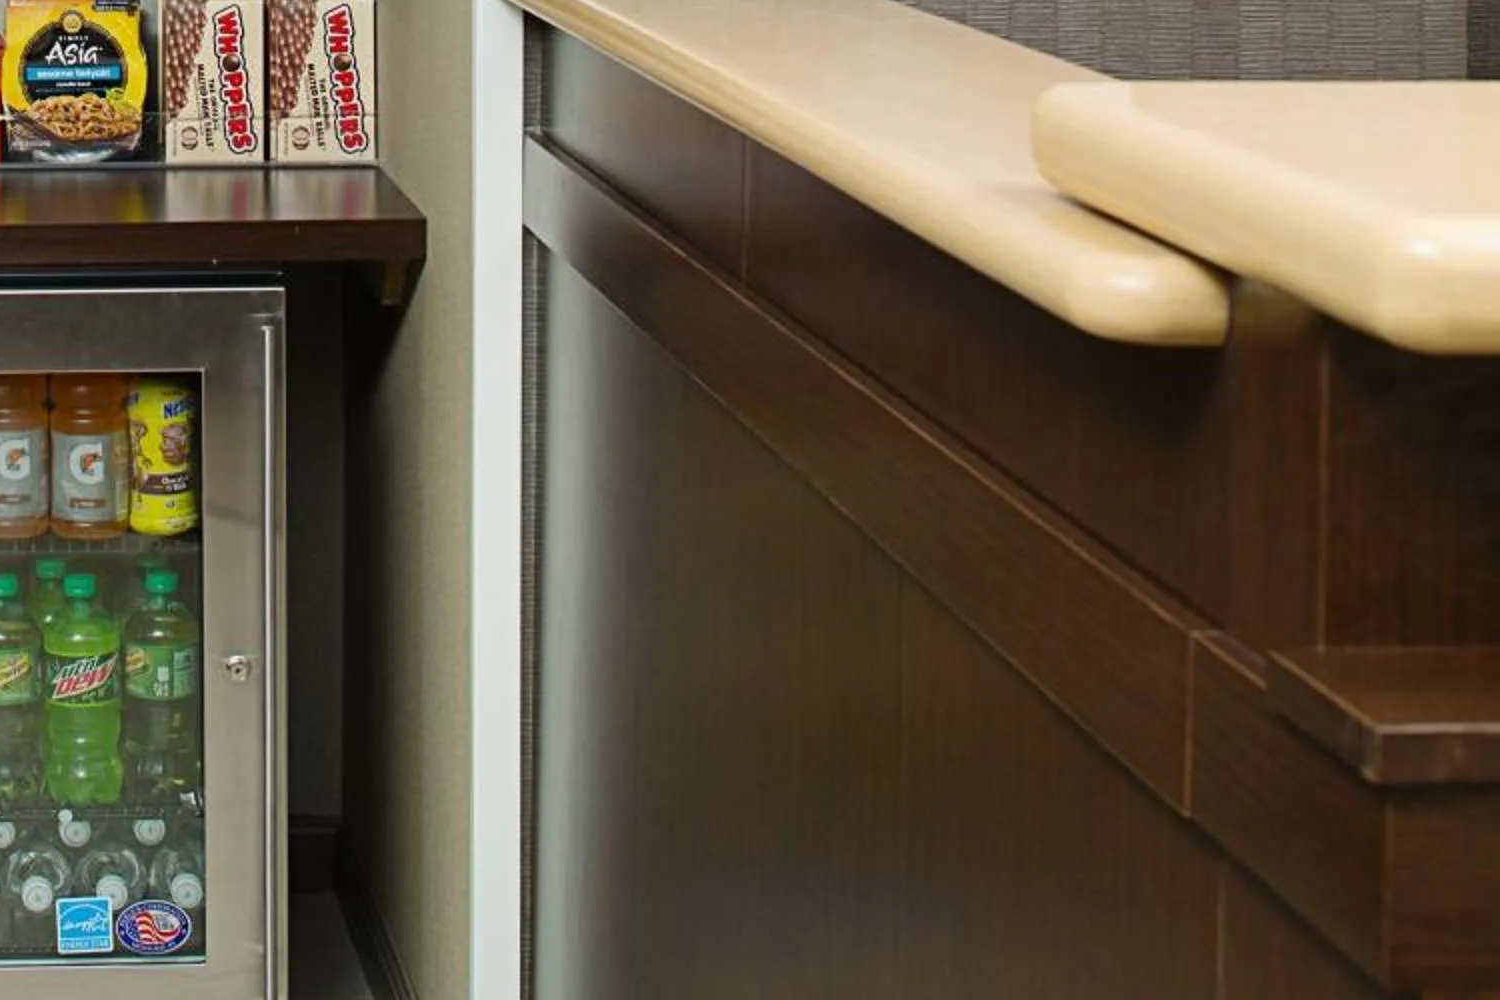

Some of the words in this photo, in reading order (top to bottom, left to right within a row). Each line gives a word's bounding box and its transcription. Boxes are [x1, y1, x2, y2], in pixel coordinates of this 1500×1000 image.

[45, 41, 99, 66] Asia
[216, 9, 254, 149] WHOPPERS
[327, 9, 366, 149] WHOPPERS
[70, 442, 104, 484] G
